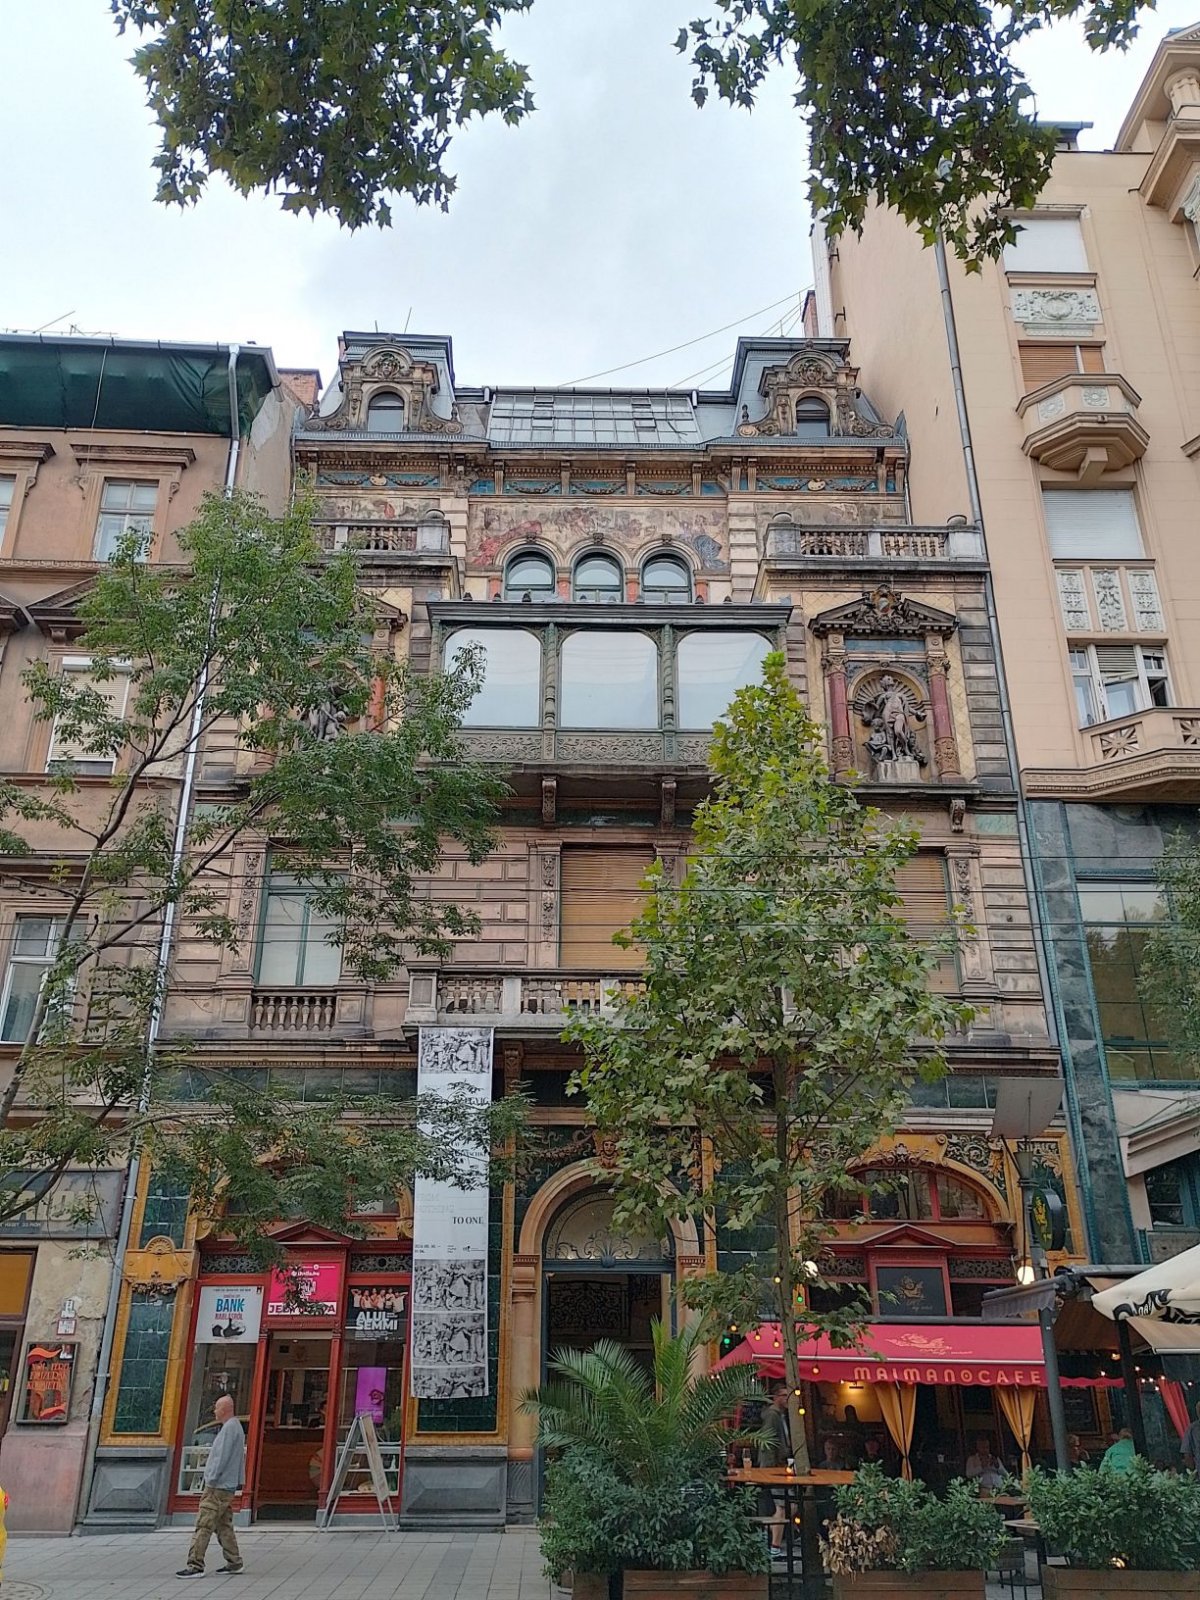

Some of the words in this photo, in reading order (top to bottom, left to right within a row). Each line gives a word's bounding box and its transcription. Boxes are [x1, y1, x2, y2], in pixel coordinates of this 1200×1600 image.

[465, 1216, 484, 1225] ONE
[216, 1298, 246, 1312] BANK
[356, 1311, 389, 1322] ALUL
[356, 1319, 398, 1330] SEMMI
